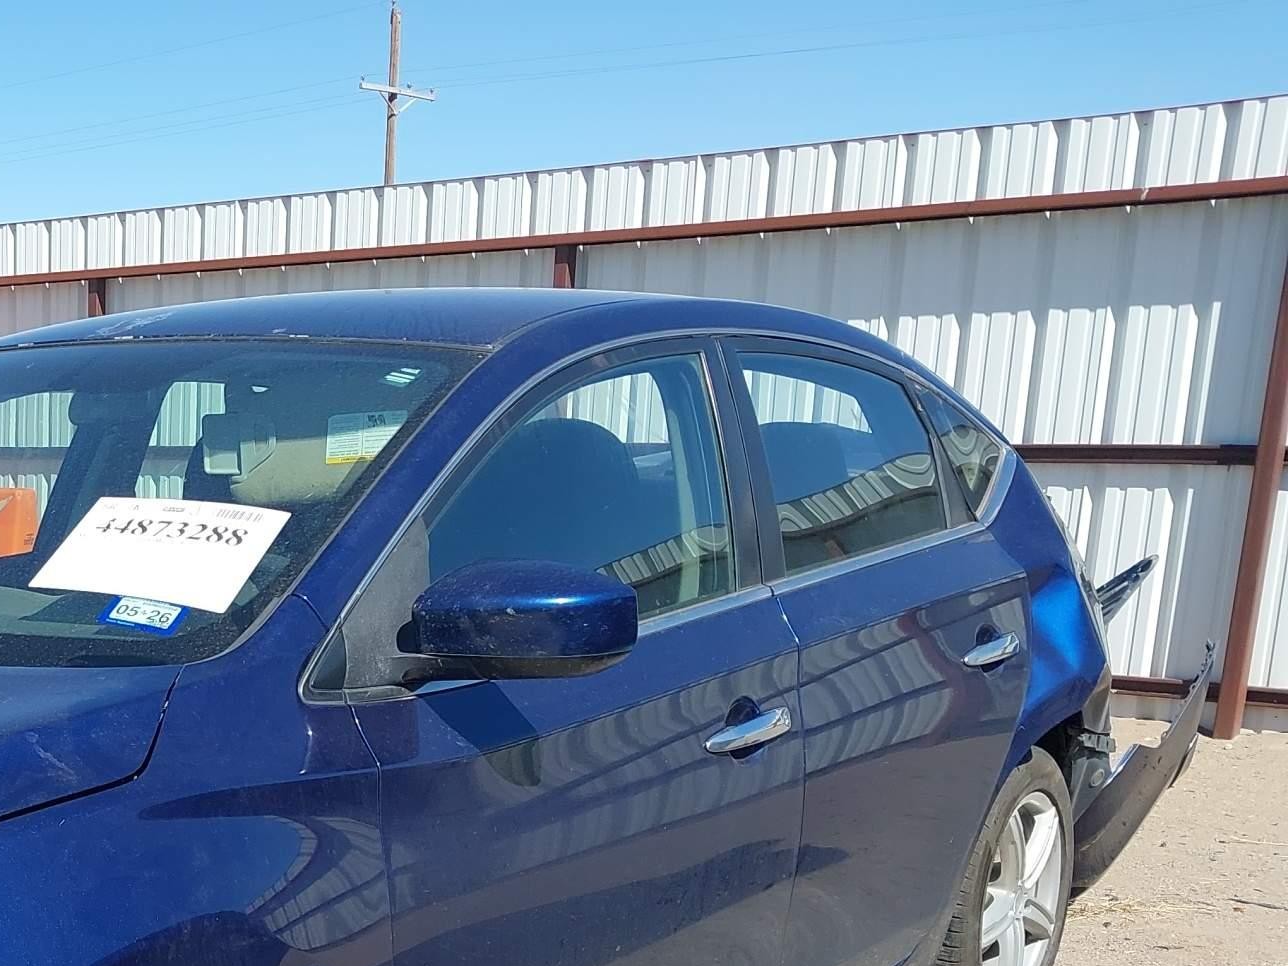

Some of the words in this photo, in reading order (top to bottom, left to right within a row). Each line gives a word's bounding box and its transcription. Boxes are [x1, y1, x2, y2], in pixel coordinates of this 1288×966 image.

[96, 518, 249, 546] 44873288
[116, 604, 141, 617] 05
[146, 609, 172, 624] 26
